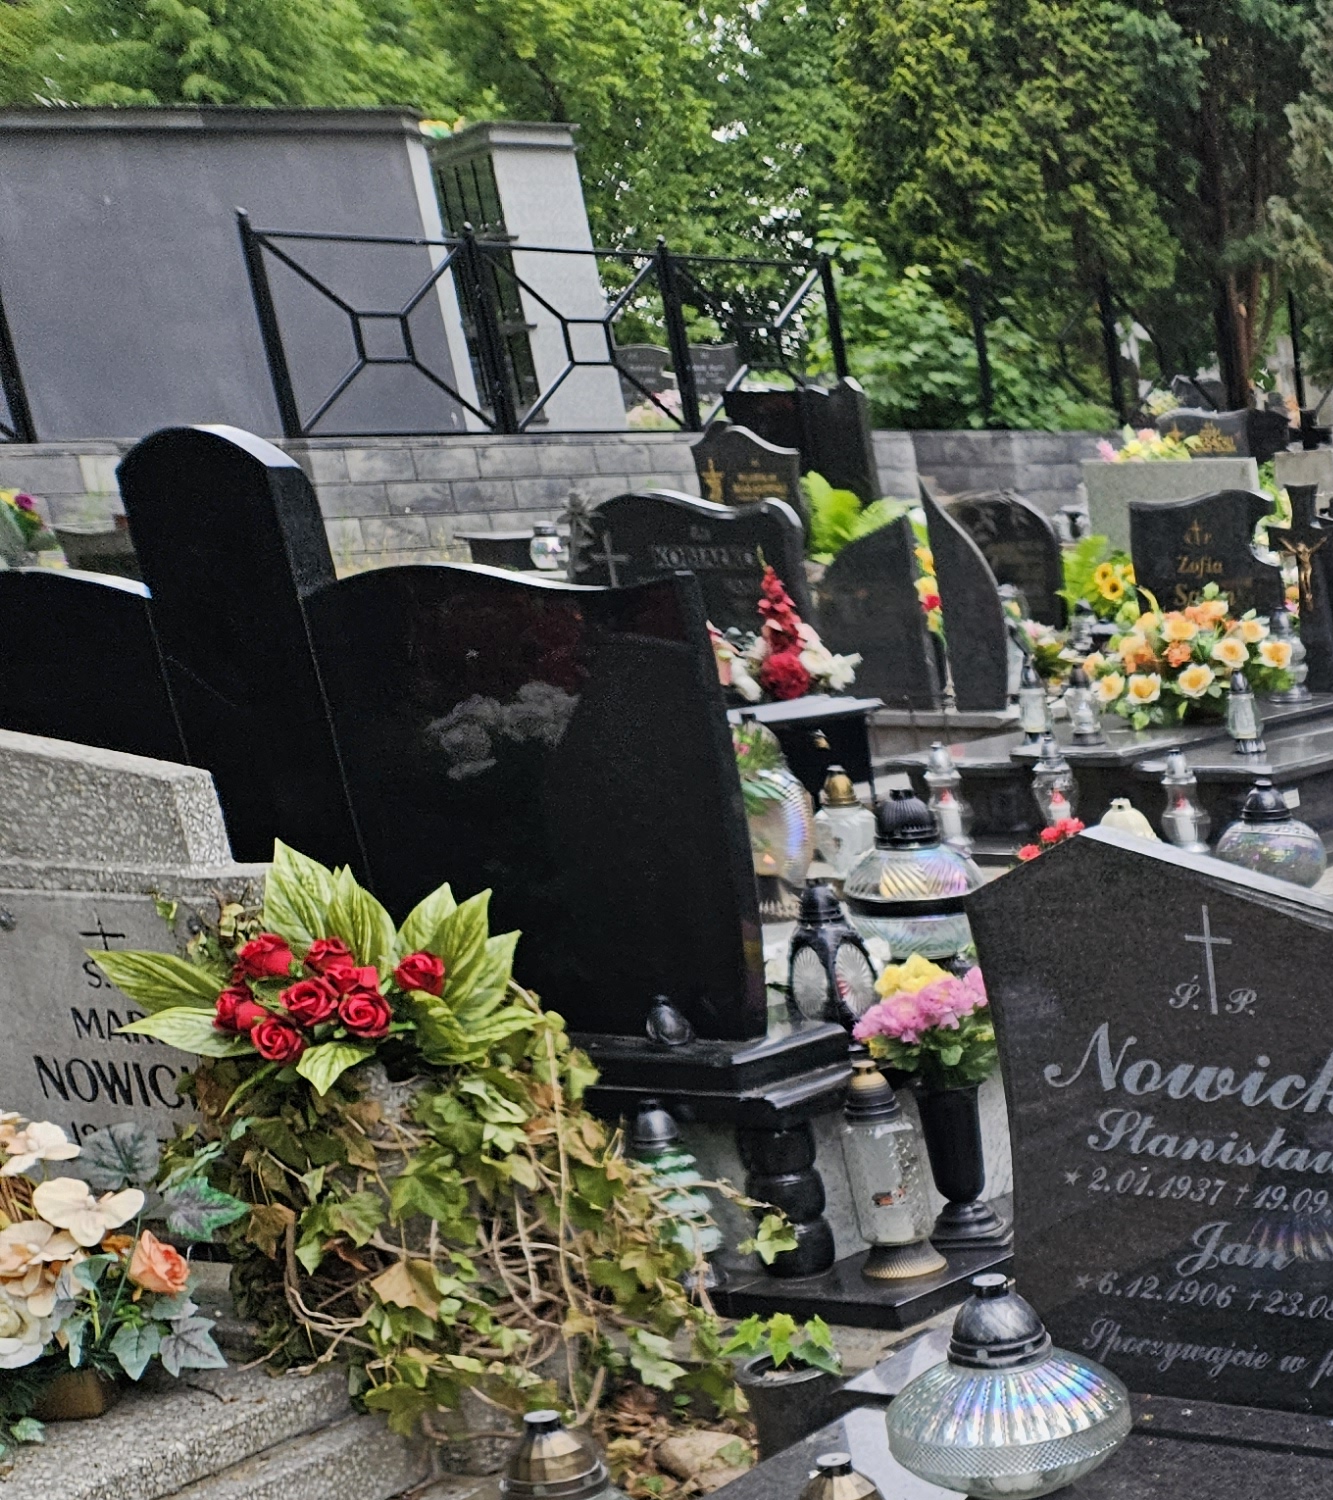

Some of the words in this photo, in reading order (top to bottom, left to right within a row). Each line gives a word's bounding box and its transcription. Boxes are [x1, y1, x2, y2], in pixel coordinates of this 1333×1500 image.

[1177, 555, 1223, 578] Zofia
[70, 1006, 166, 1045] MAR
[33, 1054, 200, 1112] NOWIC
[1088, 1166, 1230, 1206] 2.01.1937
[1176, 1221, 1302, 1277] Jan
[1099, 1271, 1237, 1309] 6.12.1906
[1082, 1317, 1274, 1379] Spoczywajcie
[1280, 1352, 1310, 1374] w
